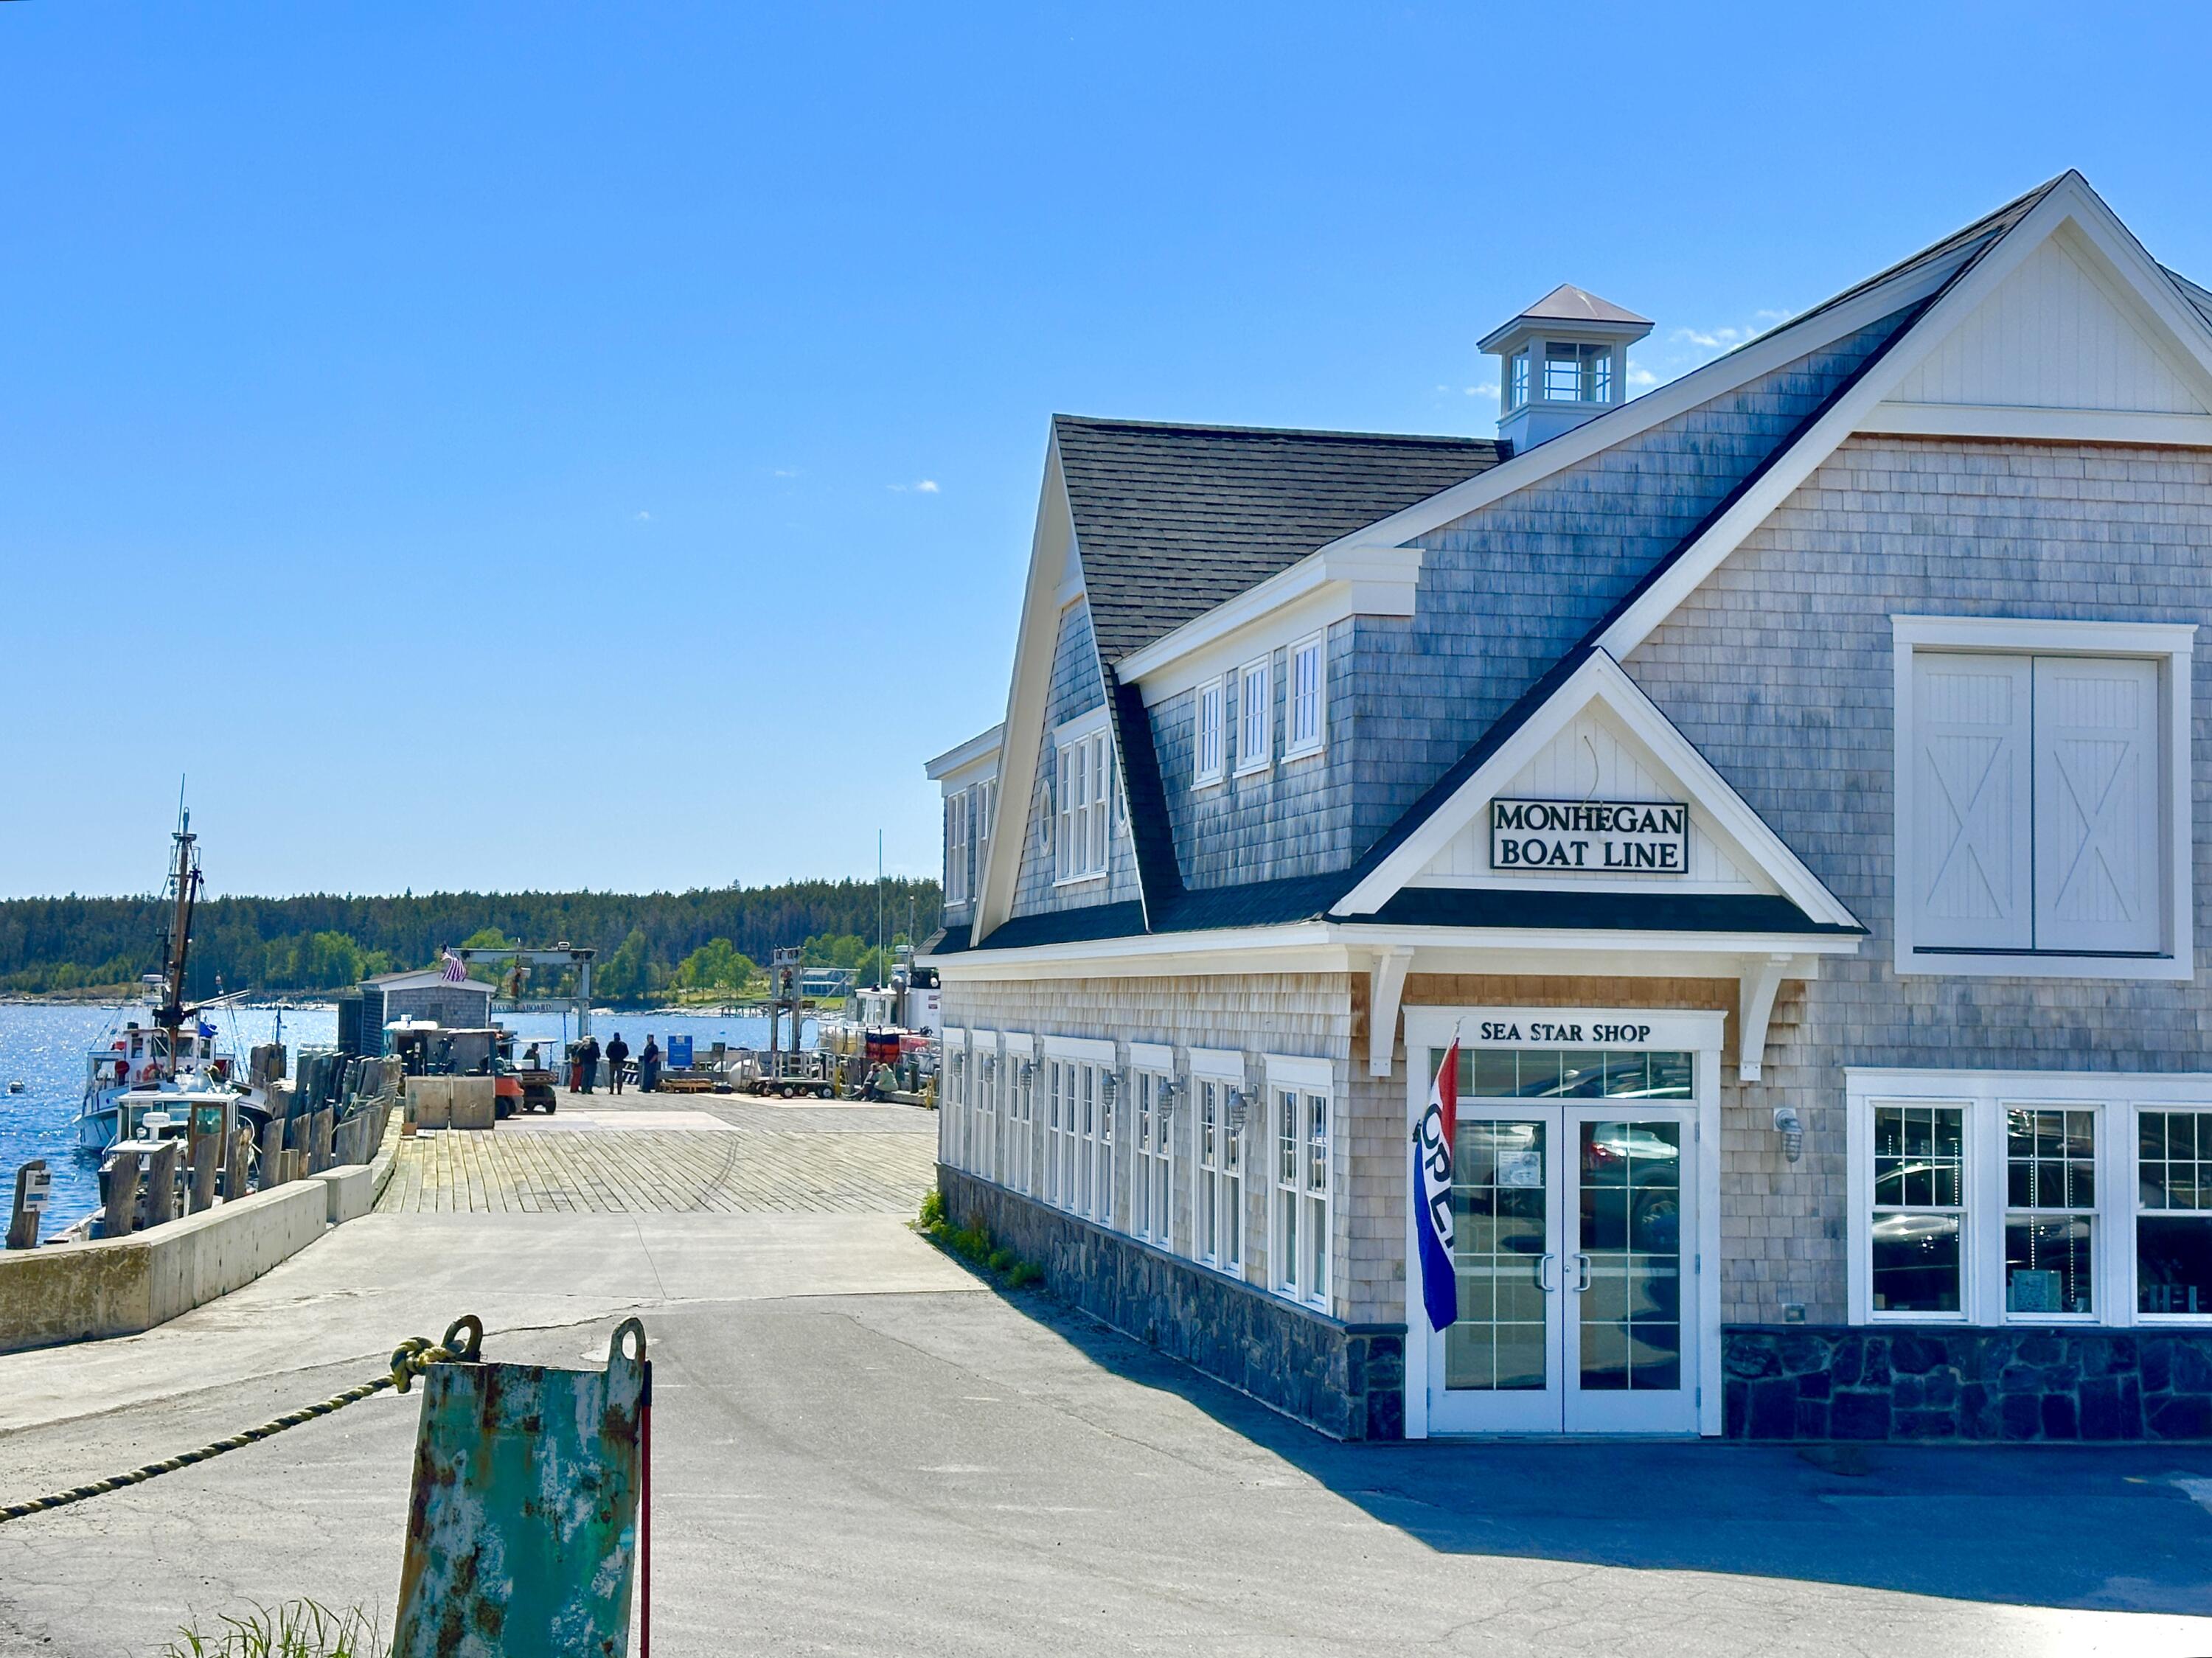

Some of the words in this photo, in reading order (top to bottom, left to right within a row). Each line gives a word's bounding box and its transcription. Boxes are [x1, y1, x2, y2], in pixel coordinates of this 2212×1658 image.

[1496, 804, 1683, 834] MONHEGAN
[1501, 838, 1588, 865] BOAT
[1604, 842, 1677, 868] LINE
[1481, 1022, 1522, 1040] SEA
[1530, 1023, 1583, 1041] STAR
[1593, 1024, 1651, 1042] SHOP
[1422, 1103, 1454, 1249] OPE
